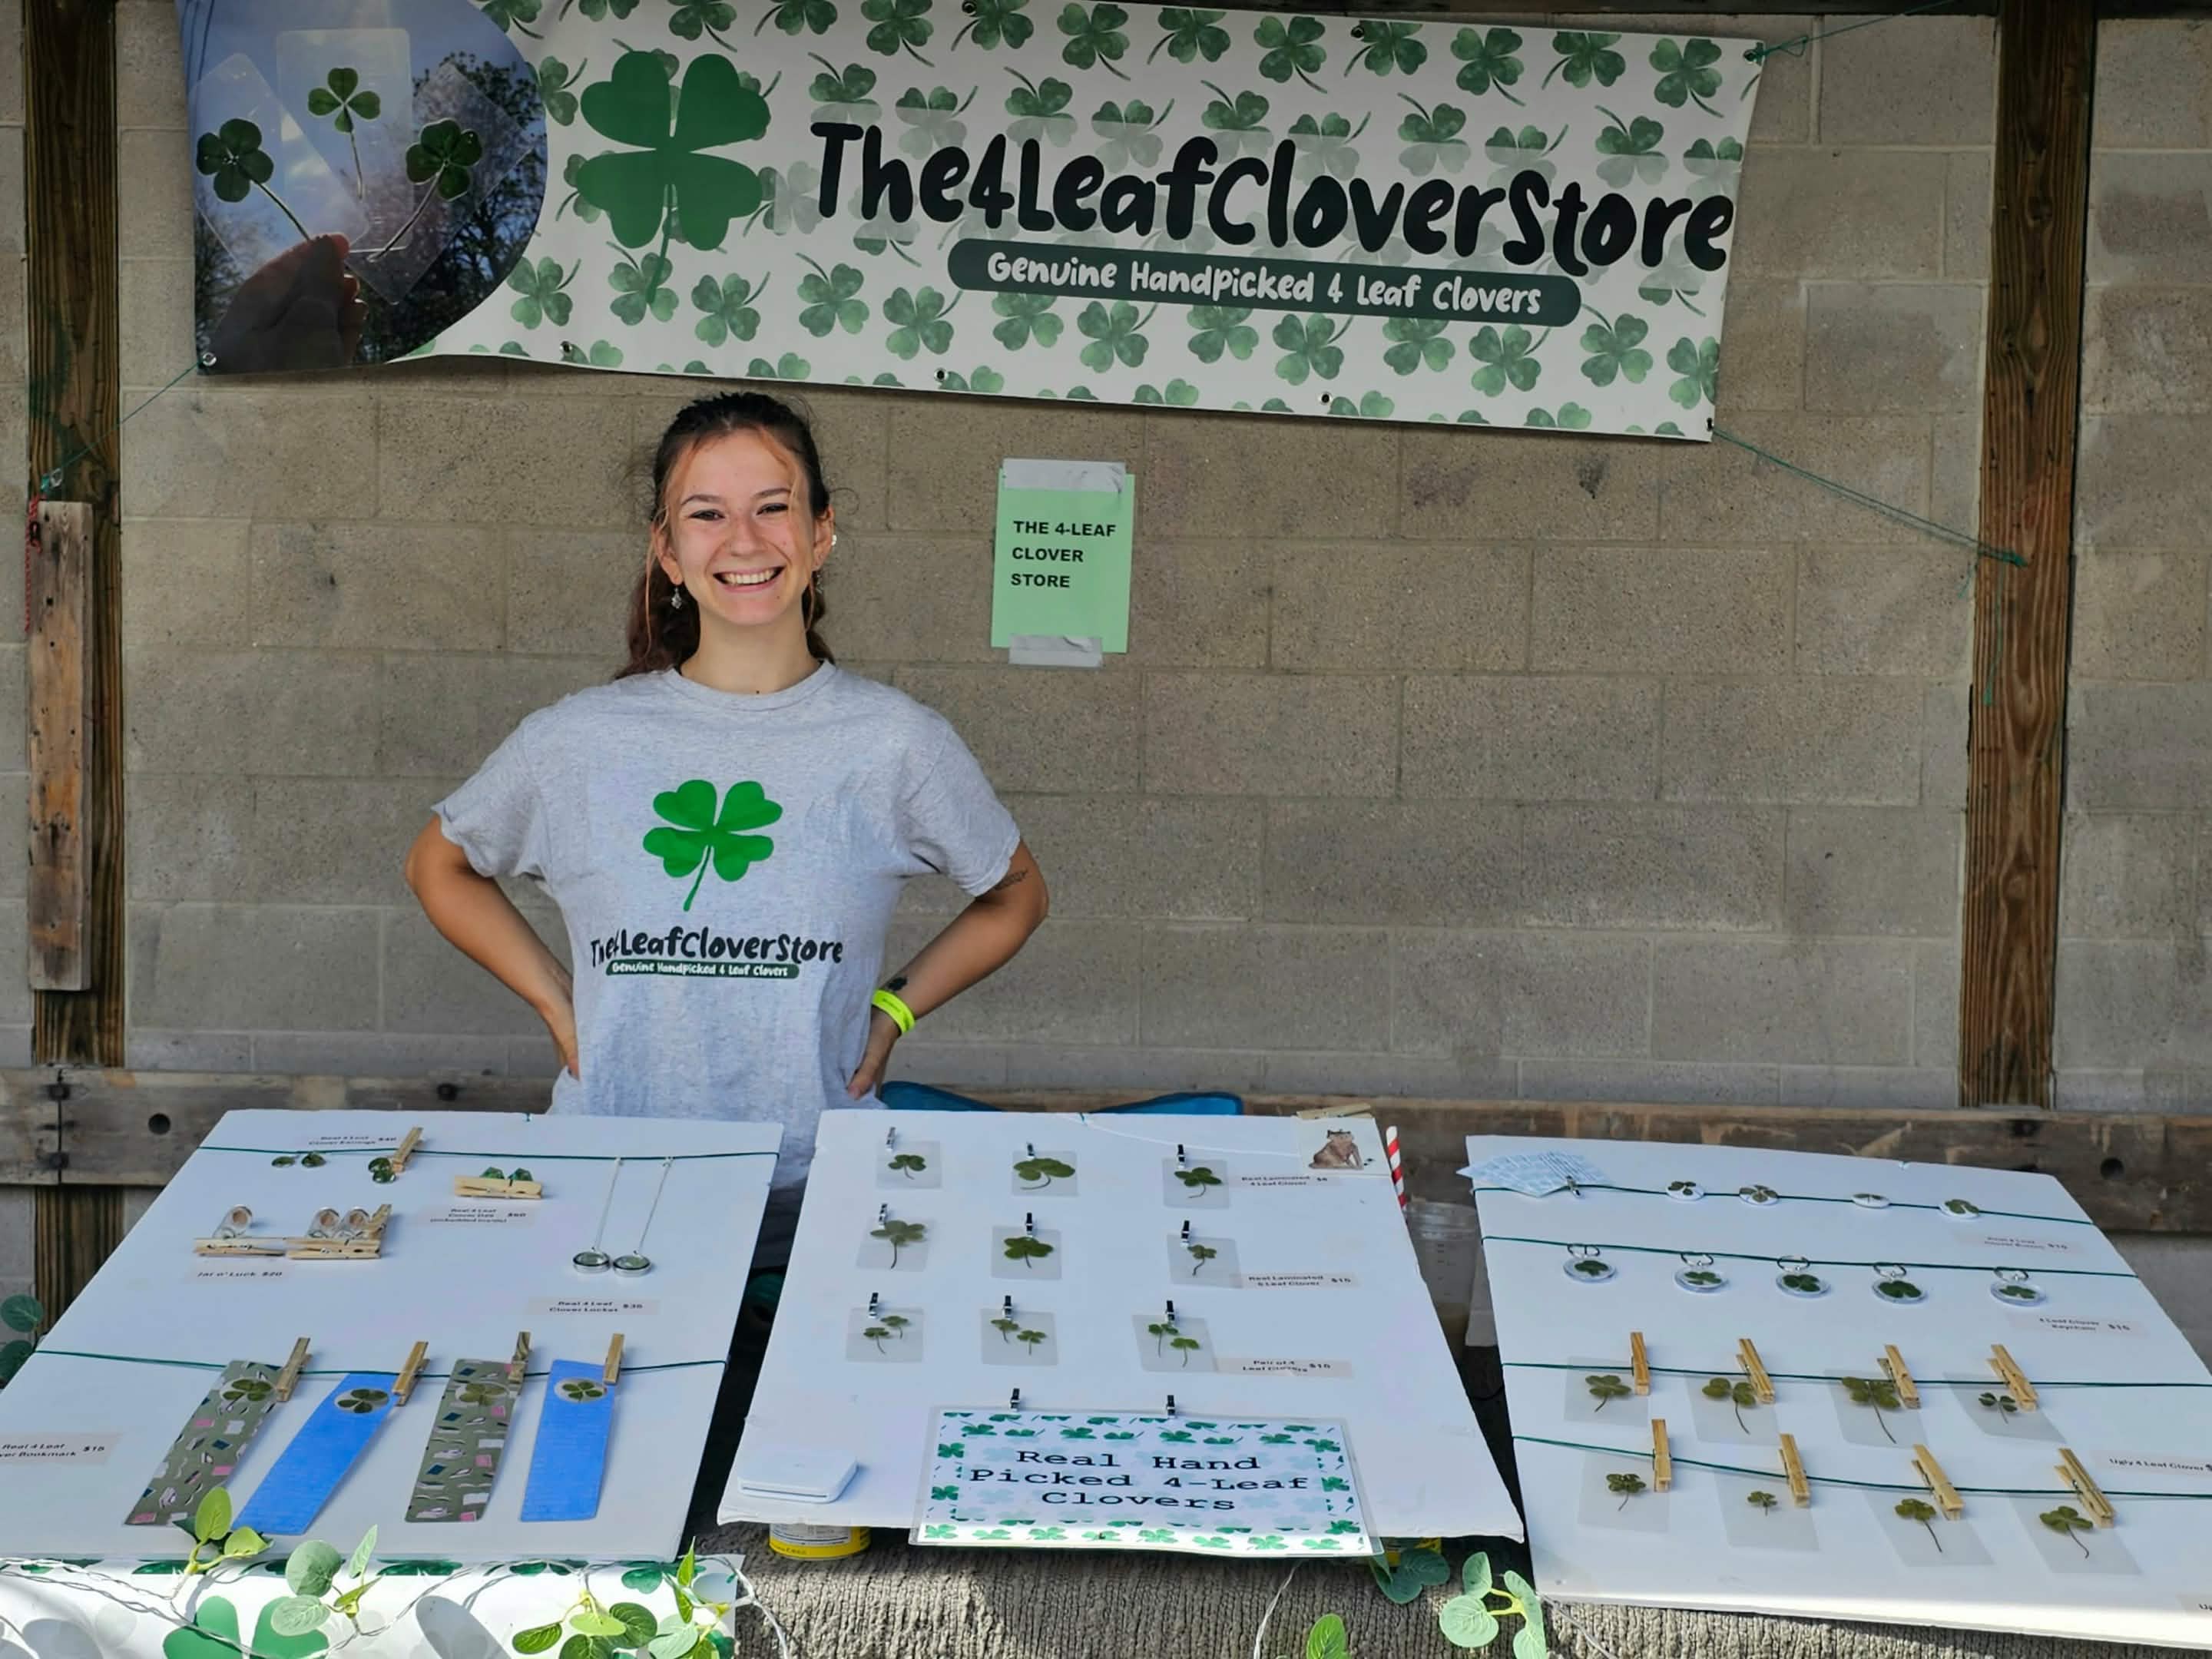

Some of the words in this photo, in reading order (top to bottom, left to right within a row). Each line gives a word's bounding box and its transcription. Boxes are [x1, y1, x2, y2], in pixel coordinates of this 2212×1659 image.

[810, 121, 1734, 277] The4LeafCloverStore
[987, 251, 1118, 288] Genuine
[1130, 260, 1315, 303] Handpicked
[1326, 272, 1344, 304] 4
[1356, 274, 1422, 307] Leaf
[1432, 276, 1542, 314] Clovers
[1013, 521, 1049, 535] THE
[1055, 522, 1117, 537] 4-LEAF
[1012, 547, 1084, 563] CLOVER
[1011, 573, 1071, 588] STORE
[612, 962, 654, 973] Genuine
[657, 962, 716, 975] Handpicked
[719, 964, 726, 975] 4
[728, 964, 750, 975] Leaf
[753, 965, 788, 977] Clovers
[1016, 1450, 1122, 1468] Real
[1152, 1455, 1262, 1470] Hand
[969, 1469, 1134, 1487] Picked
[1164, 1476, 1309, 1491] 4-Leaf
[1042, 1492, 1236, 1512] Clovers
